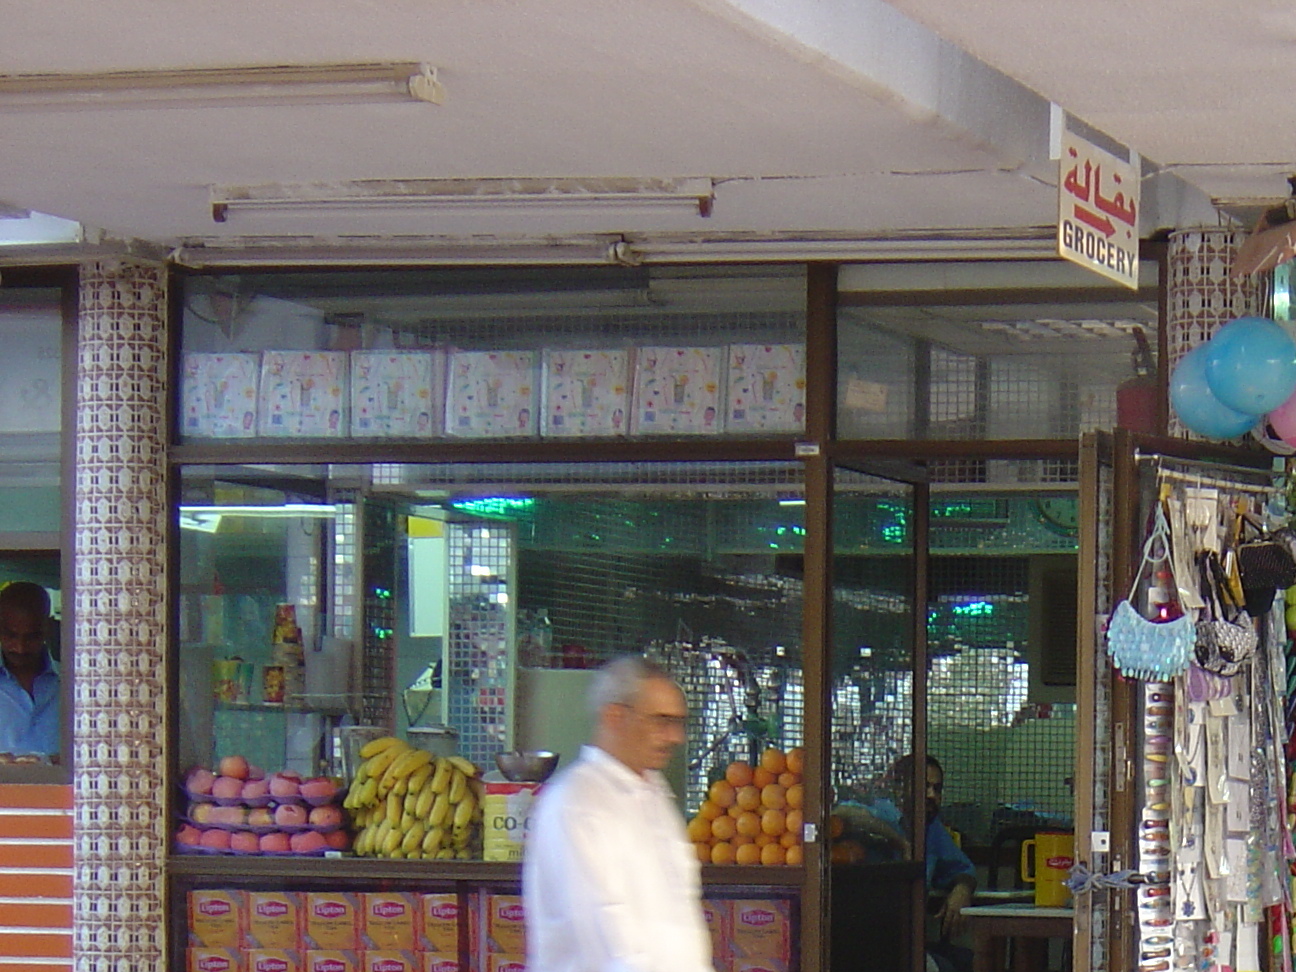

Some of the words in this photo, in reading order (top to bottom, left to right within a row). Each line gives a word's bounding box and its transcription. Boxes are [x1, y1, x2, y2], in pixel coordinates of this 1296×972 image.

[1064, 146, 1136, 240] بقالة
[1063, 219, 1136, 278] GROCERY
[201, 903, 230, 916] Lipton
[258, 904, 287, 917] Lipton
[315, 904, 345, 916] Lipton
[374, 904, 404, 916] Lipton
[433, 906, 459, 918] Lipto
[742, 913, 774, 925] Lipton
[200, 959, 229, 972] Lipton
